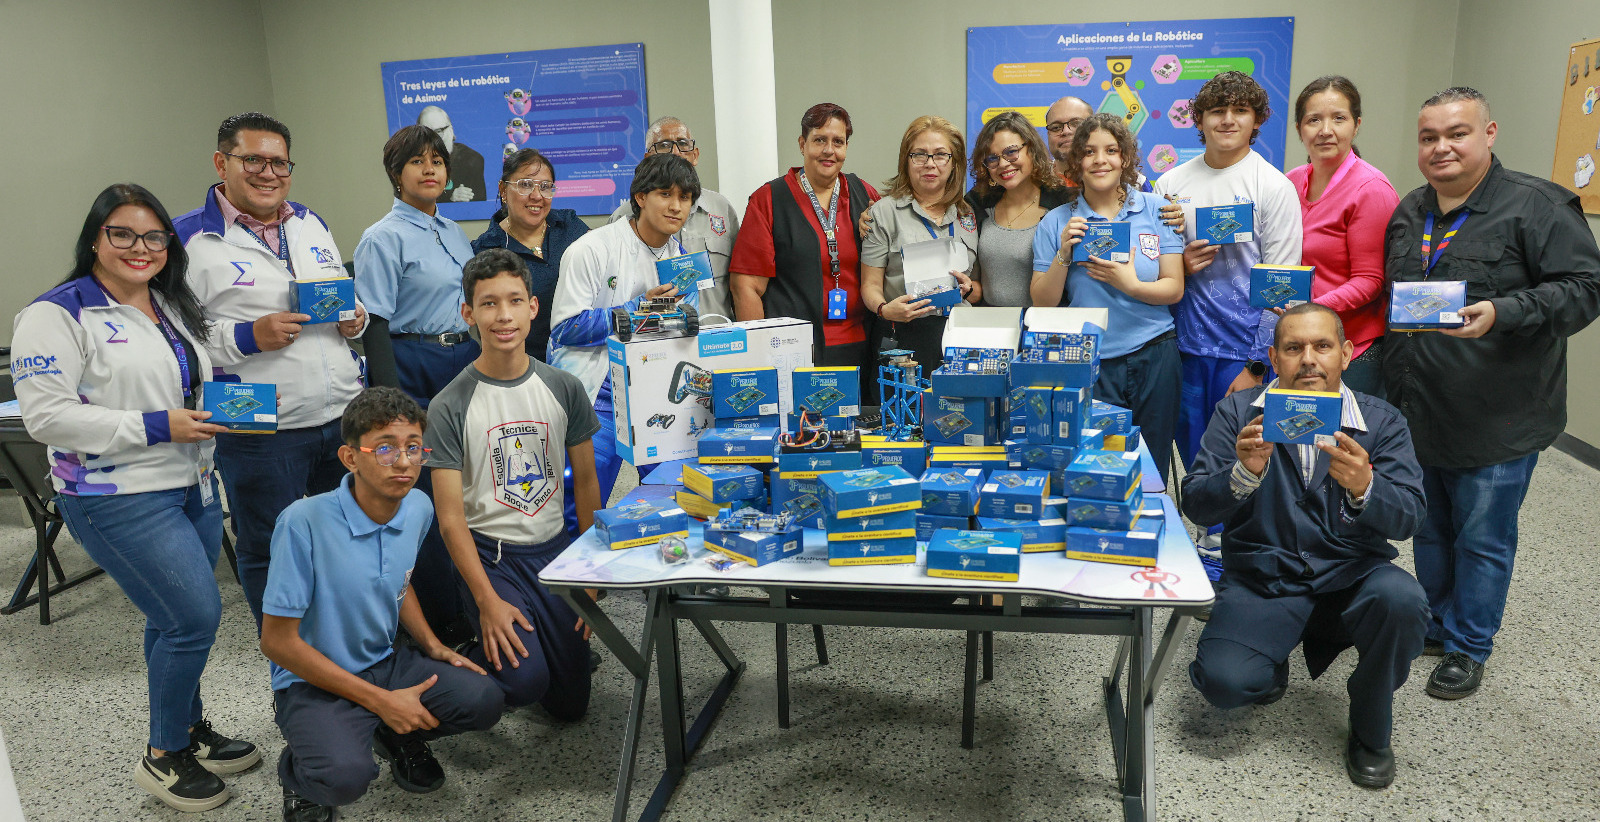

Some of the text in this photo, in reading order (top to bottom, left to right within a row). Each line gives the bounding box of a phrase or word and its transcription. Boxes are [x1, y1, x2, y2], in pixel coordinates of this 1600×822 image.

[1057, 30, 1203, 46] Aplicaciones de la Robótica
[400, 75, 510, 91] Tres leyes de la robótica
[402, 93, 447, 104] de Asimov
[499, 425, 538, 436] Técnica
[492, 448, 504, 486] Escuela
[504, 493, 528, 512] Roque
[534, 488, 552, 507] Pinto
